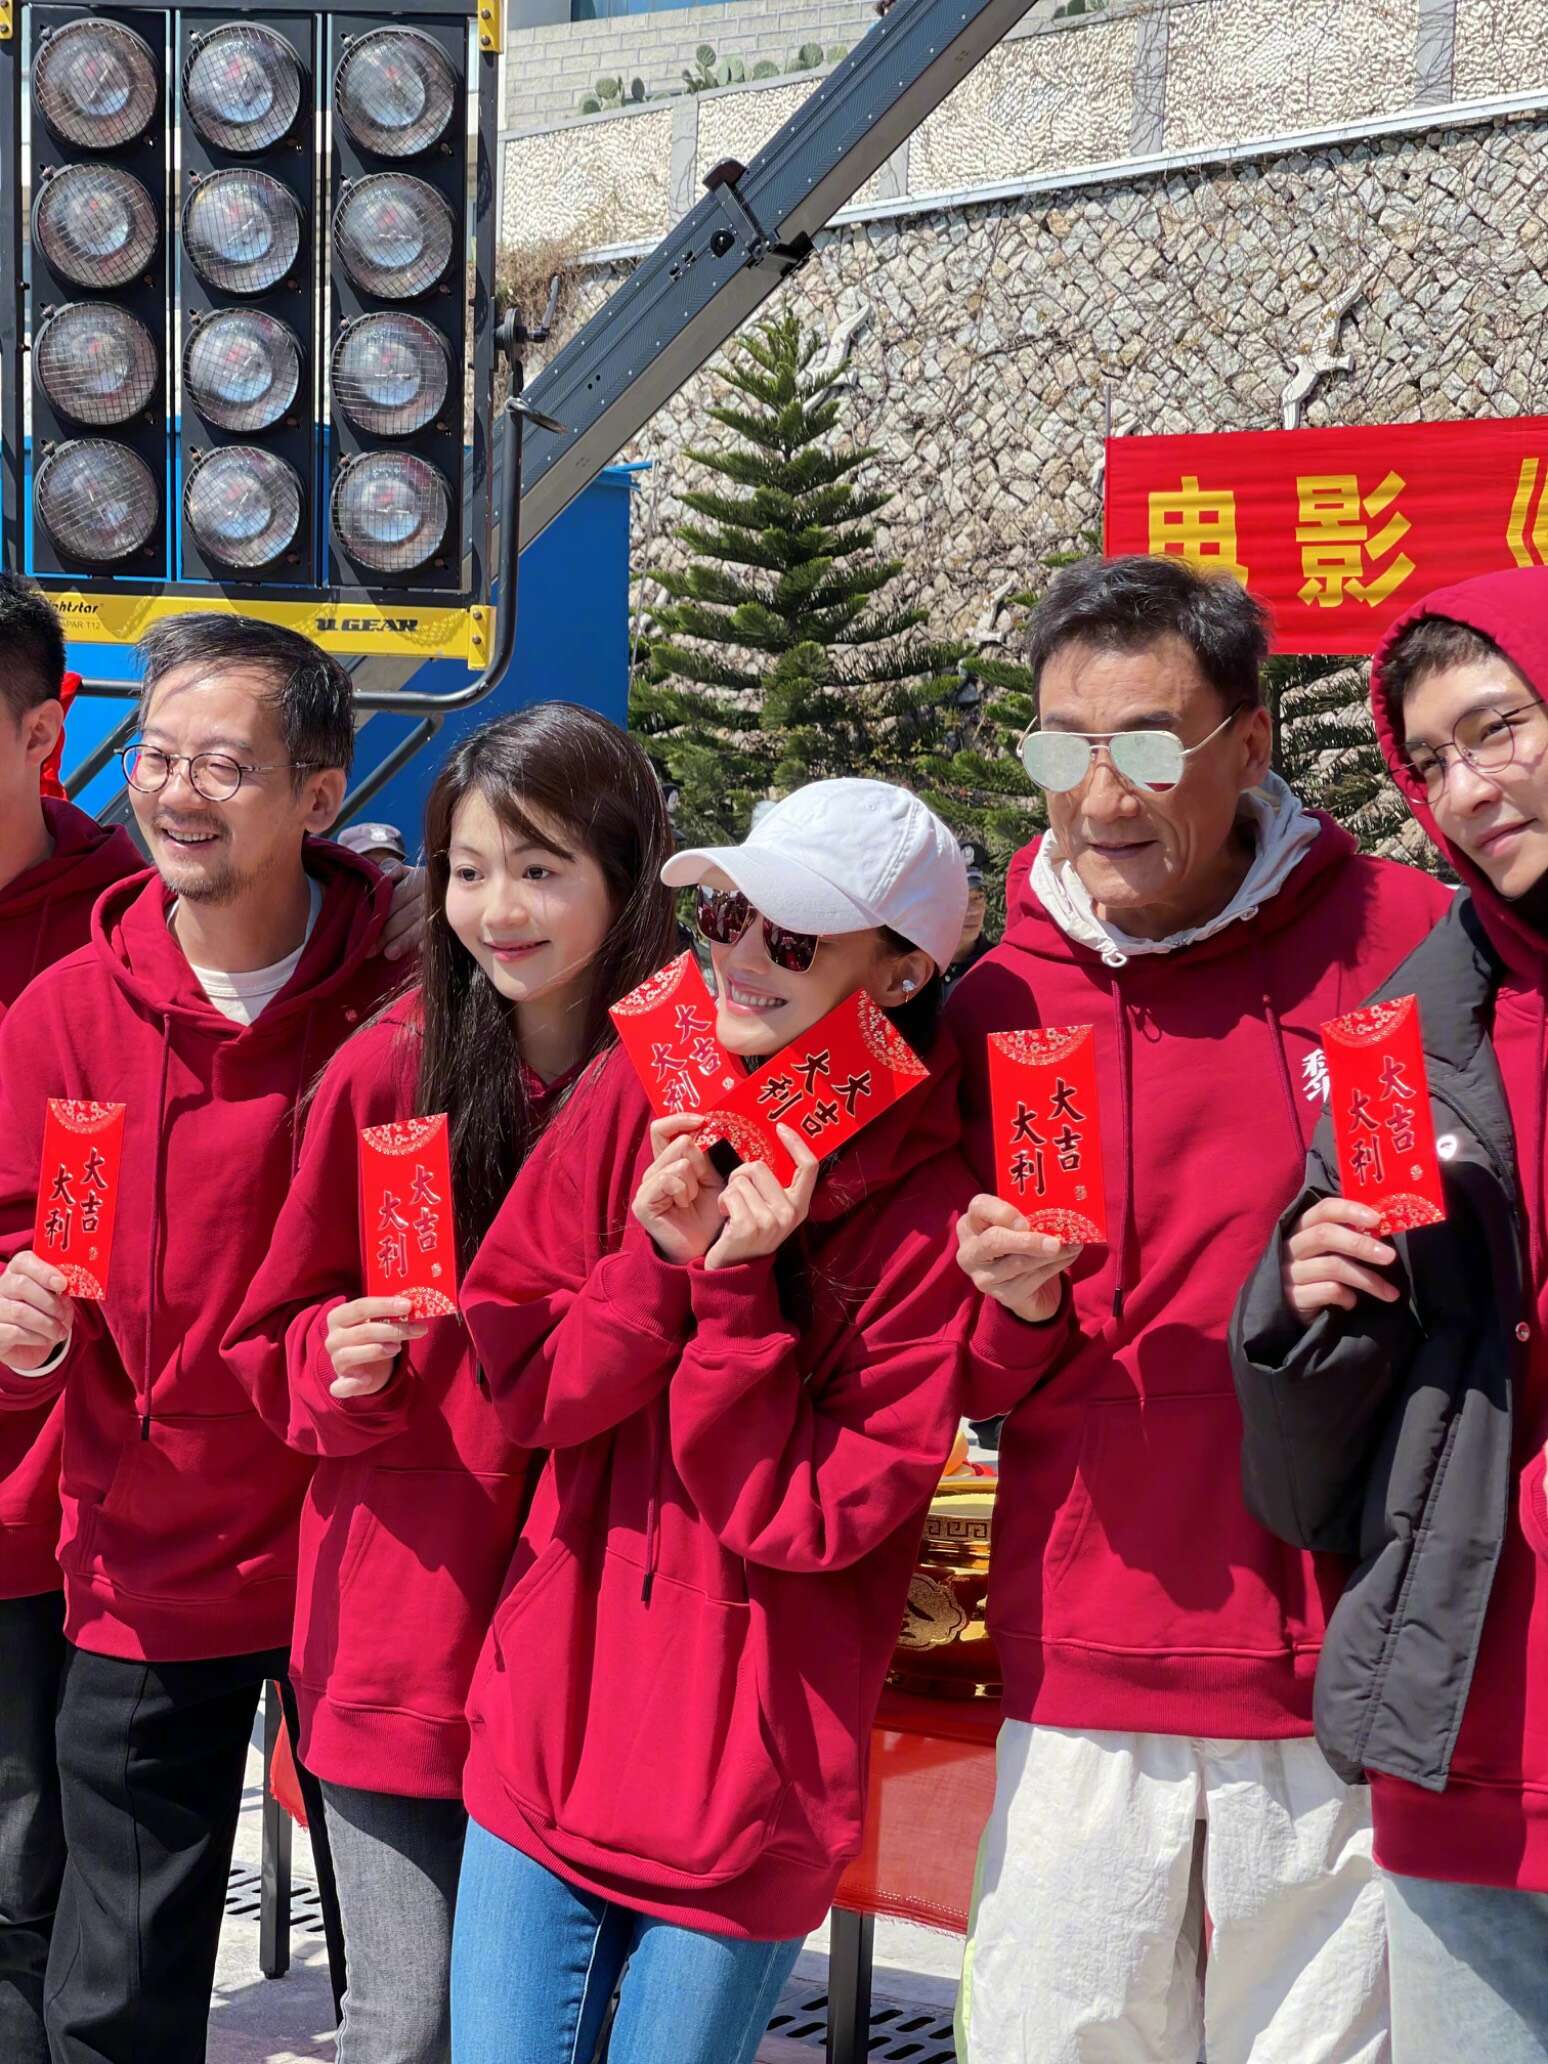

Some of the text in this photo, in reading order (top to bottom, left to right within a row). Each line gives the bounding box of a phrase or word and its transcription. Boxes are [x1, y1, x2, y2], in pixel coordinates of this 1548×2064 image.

[651, 1043, 700, 1113] 大利
[675, 1004, 722, 1075] 大吉
[756, 1048, 830, 1121] 大利
[802, 1070, 872, 1137] 大吉
[1048, 1077, 1087, 1173] 大吉
[1378, 1055, 1417, 1153] 大吉
[1009, 1101, 1047, 1197] 大利
[1346, 1089, 1384, 1186] 大利
[44, 1163, 77, 1252] 大利
[80, 1146, 108, 1233] 大吉
[409, 1164, 442, 1254] 大吉
[376, 1190, 409, 1279] 大利
